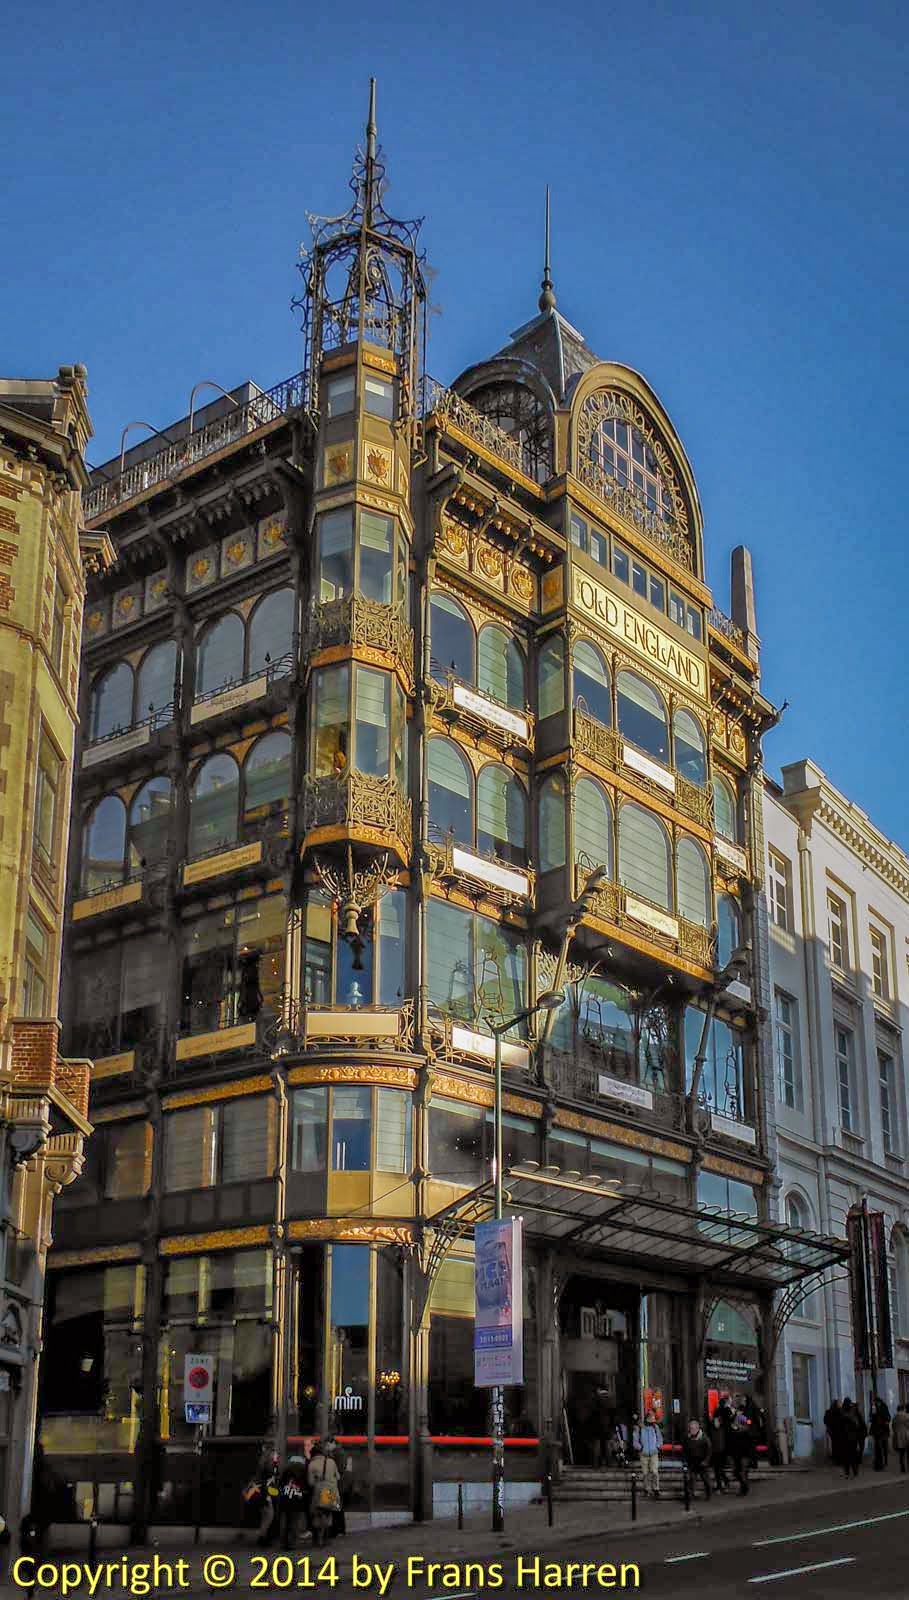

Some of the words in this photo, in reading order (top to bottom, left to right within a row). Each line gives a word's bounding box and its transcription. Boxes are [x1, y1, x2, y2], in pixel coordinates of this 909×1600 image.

[580, 580, 618, 627] OLD
[623, 609, 700, 688] ENGLAND
[334, 1386, 363, 1410] mim
